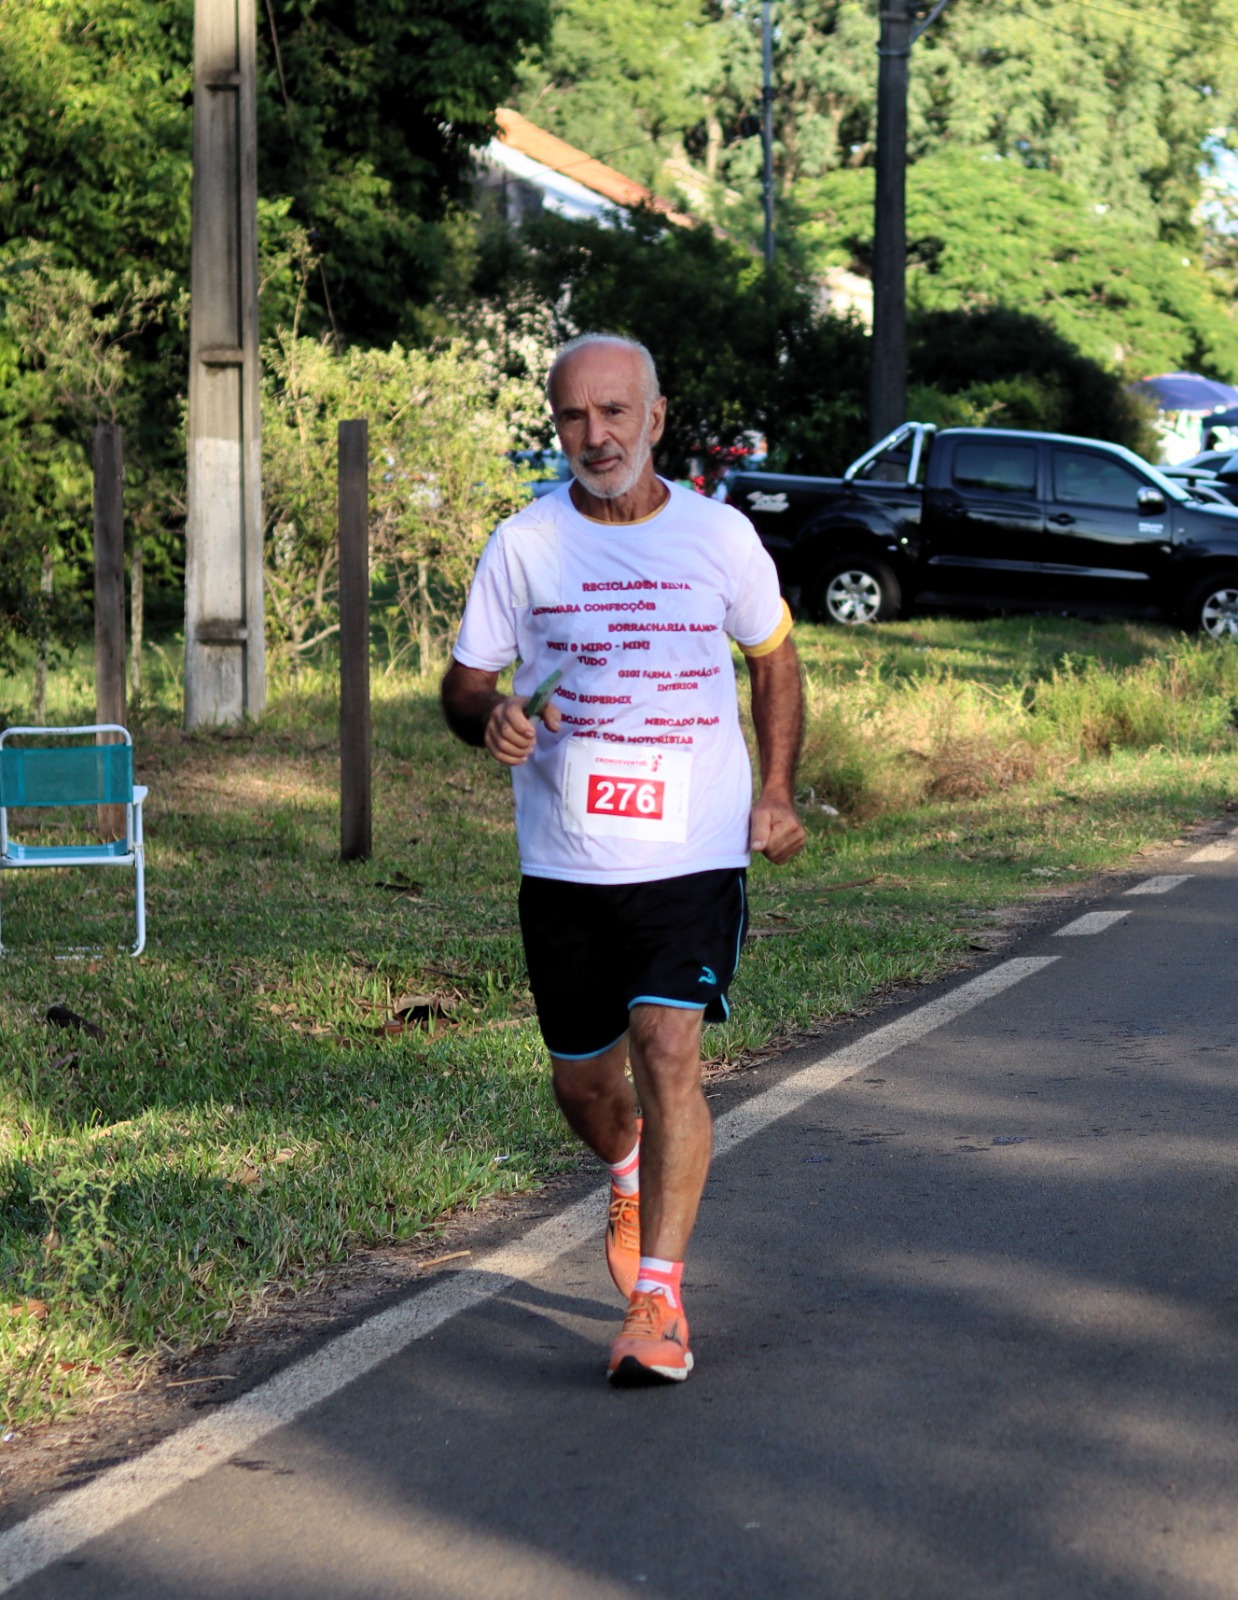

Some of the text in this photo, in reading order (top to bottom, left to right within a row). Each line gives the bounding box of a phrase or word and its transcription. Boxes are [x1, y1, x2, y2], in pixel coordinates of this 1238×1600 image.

[582, 580, 692, 592] RECICLAGEM SILVA
[608, 623, 686, 633] BORRACHARIA
[577, 655, 608, 666] TUDO
[642, 669, 672, 679] FARMA
[657, 682, 698, 692] INTERIOR
[553, 685, 633, 705] ÓRIO SUPERMIX
[560, 713, 594, 726] RCADO
[644, 716, 695, 727] MERCADO
[627, 735, 694, 745] MOTORISTAS
[594, 780, 657, 814] 276
